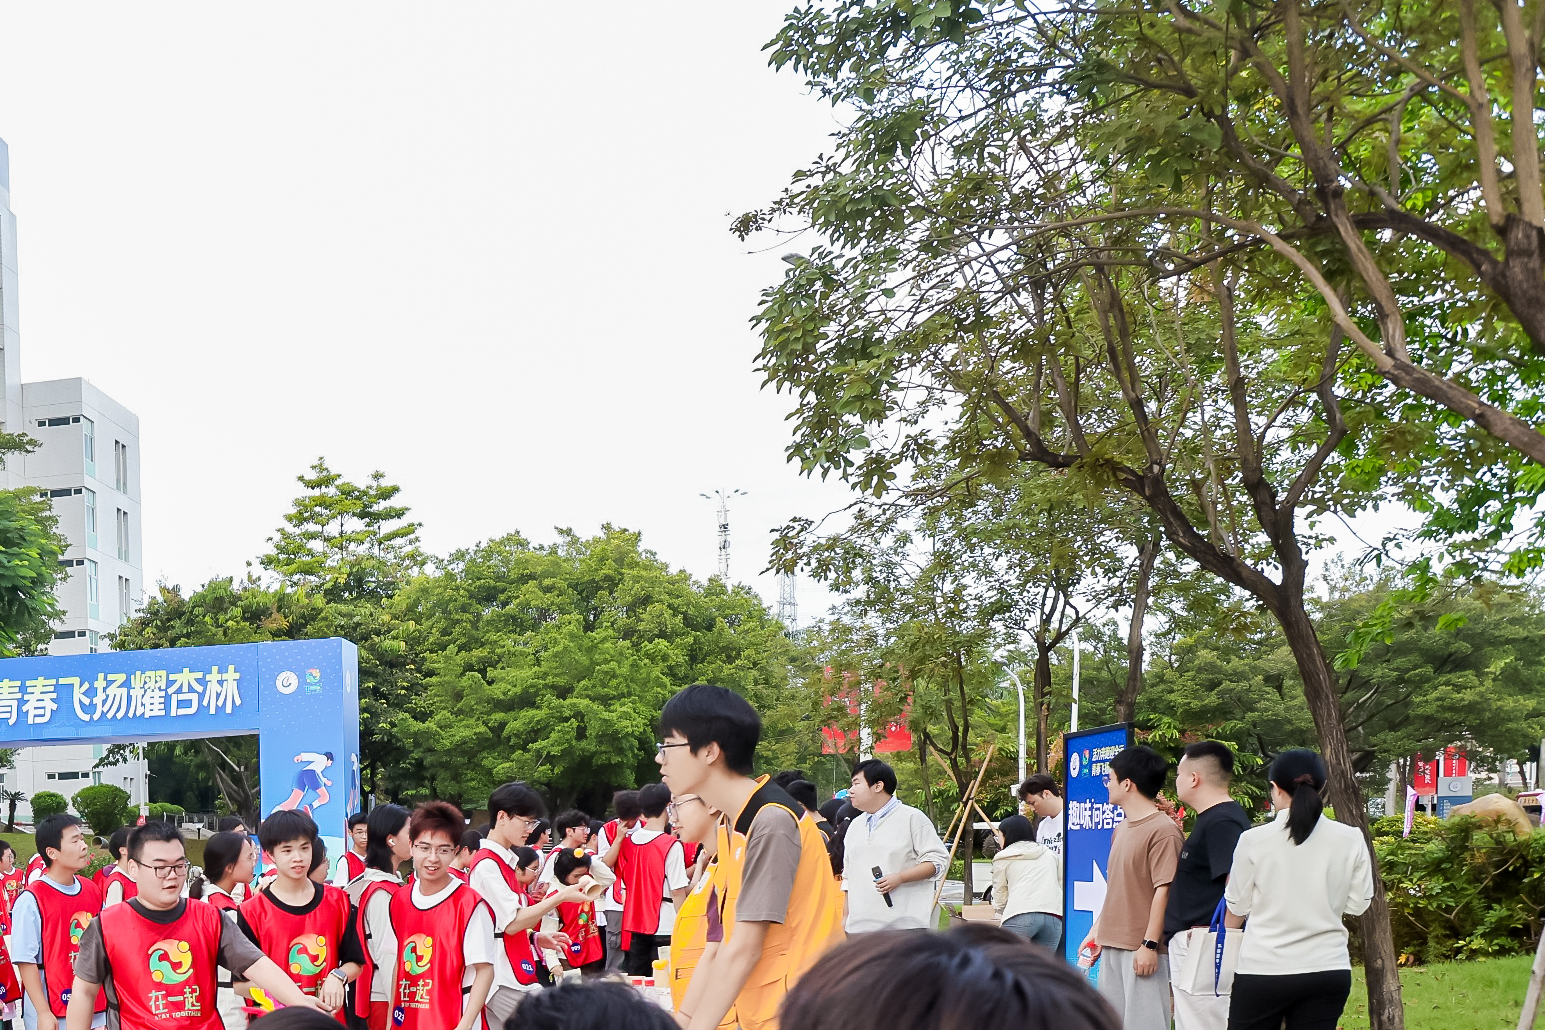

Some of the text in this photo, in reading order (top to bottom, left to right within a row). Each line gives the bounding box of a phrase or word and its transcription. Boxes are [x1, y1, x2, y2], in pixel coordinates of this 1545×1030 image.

[148, 985, 201, 1014] 在一起
[399, 978, 432, 1002] 在一起
